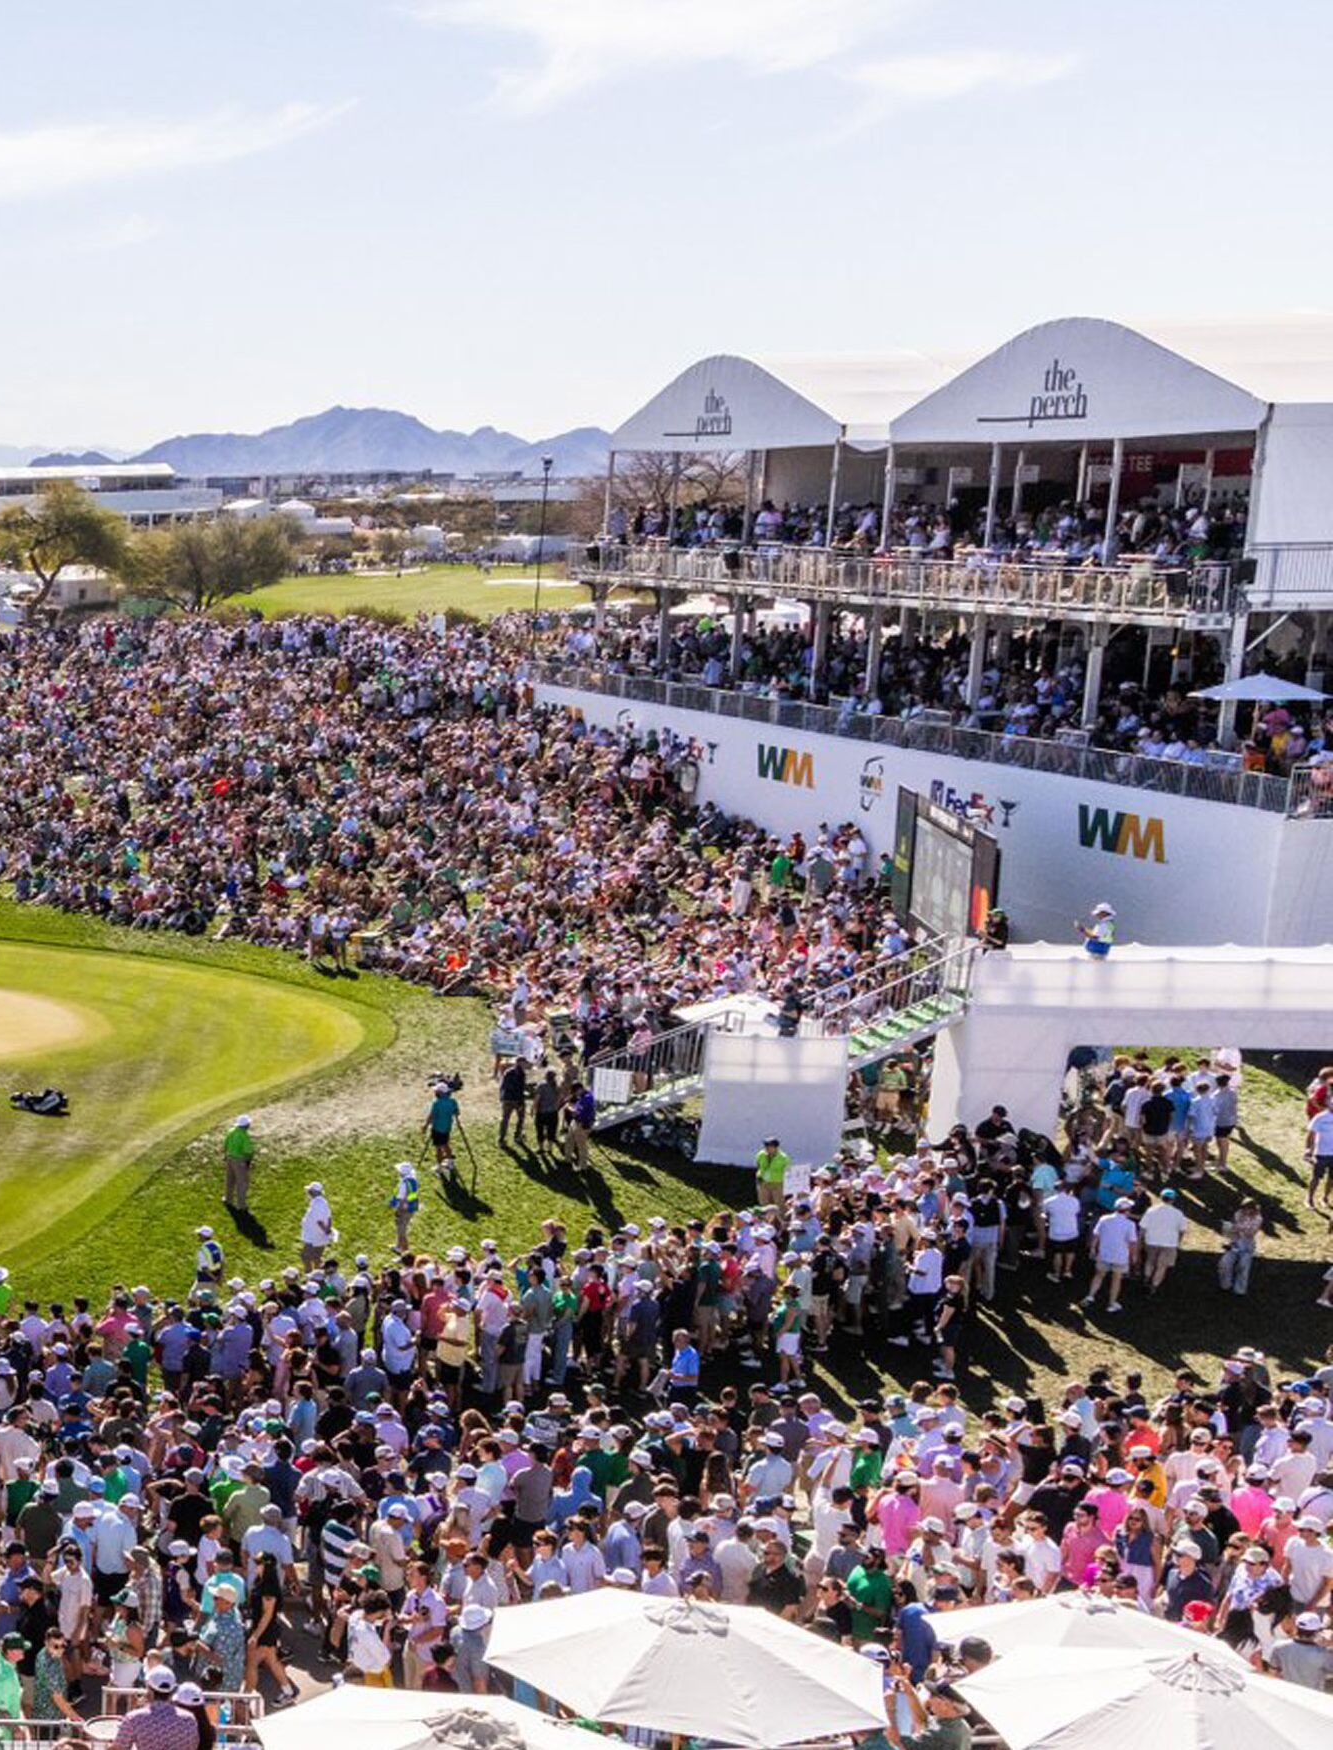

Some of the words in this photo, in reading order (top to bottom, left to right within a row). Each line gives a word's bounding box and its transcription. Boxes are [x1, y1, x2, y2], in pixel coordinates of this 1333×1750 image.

[1044, 358, 1076, 392] the
[704, 388, 725, 413] the
[1028, 383, 1088, 428] perch
[695, 406, 732, 443] perch
[757, 743, 815, 789] WM
[945, 787, 995, 824] FedEx
[1078, 803, 1166, 864] WM
